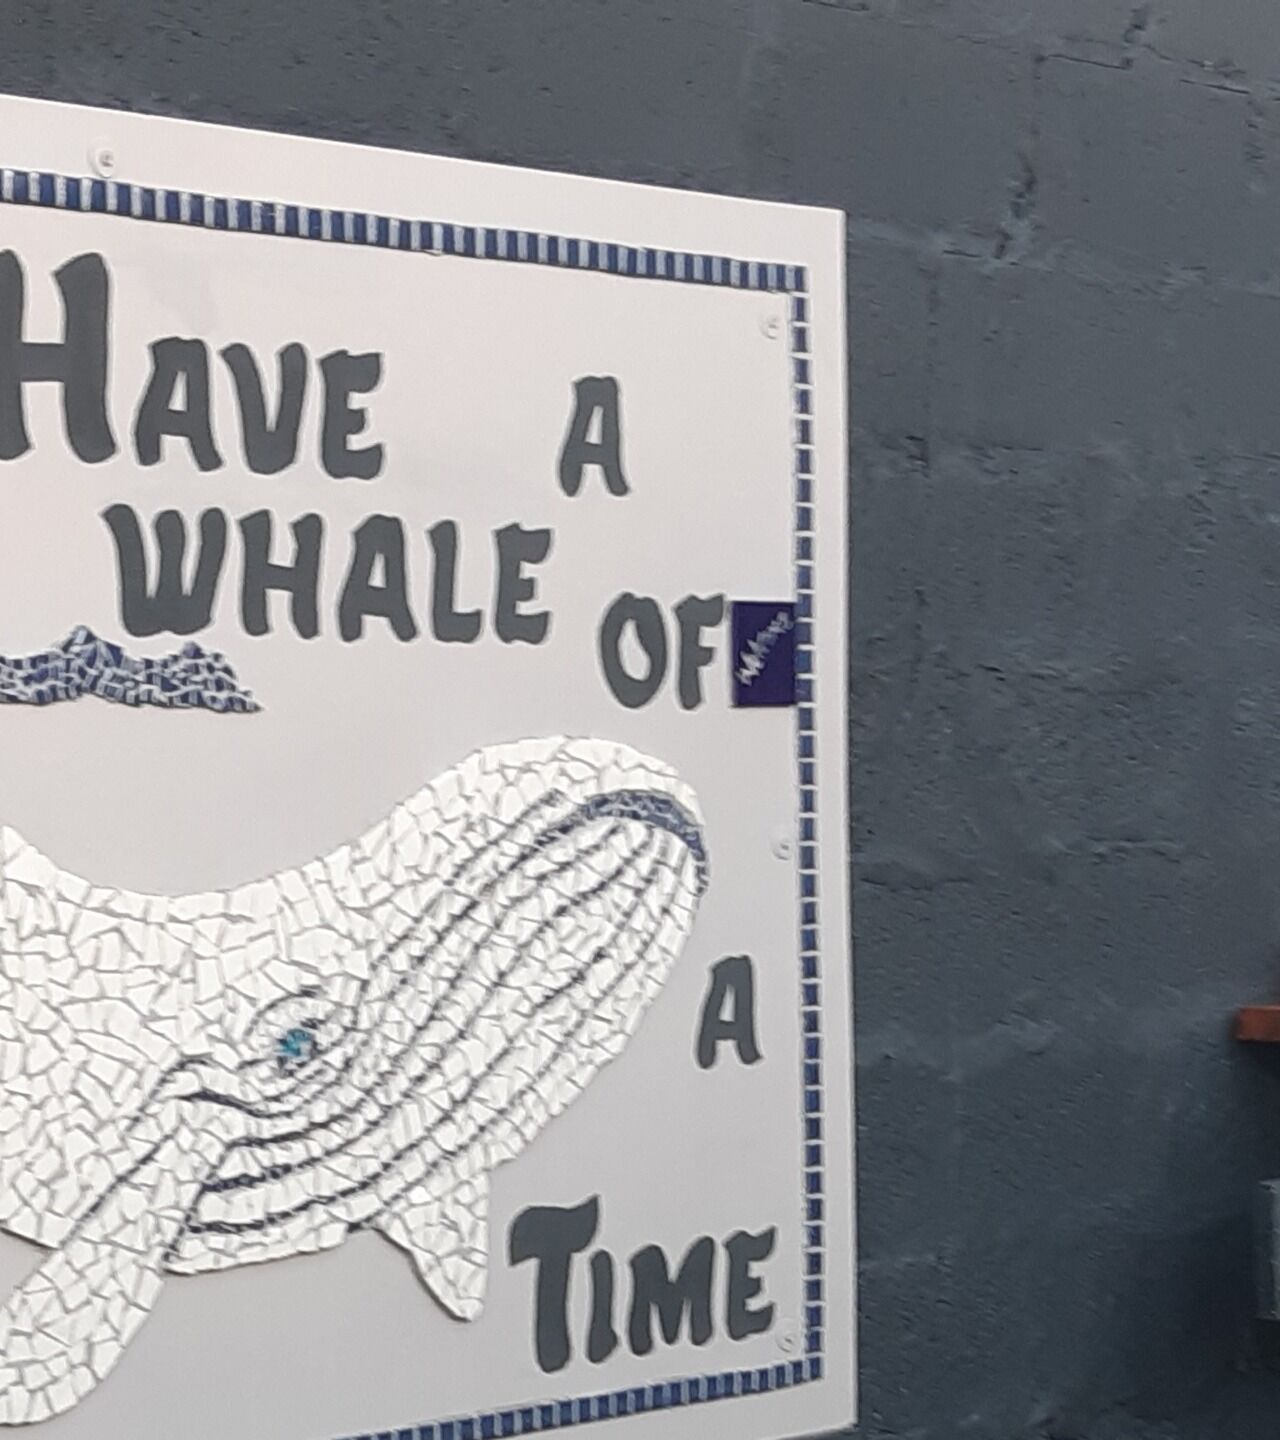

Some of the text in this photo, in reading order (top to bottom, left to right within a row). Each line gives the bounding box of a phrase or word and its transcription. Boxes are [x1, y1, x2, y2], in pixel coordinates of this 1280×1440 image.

[558, 376, 629, 496] A
[102, 504, 552, 643] WHALE
[600, 593, 724, 710] OF
[696, 955, 762, 1069] A
[508, 1195, 777, 1374] TIME
